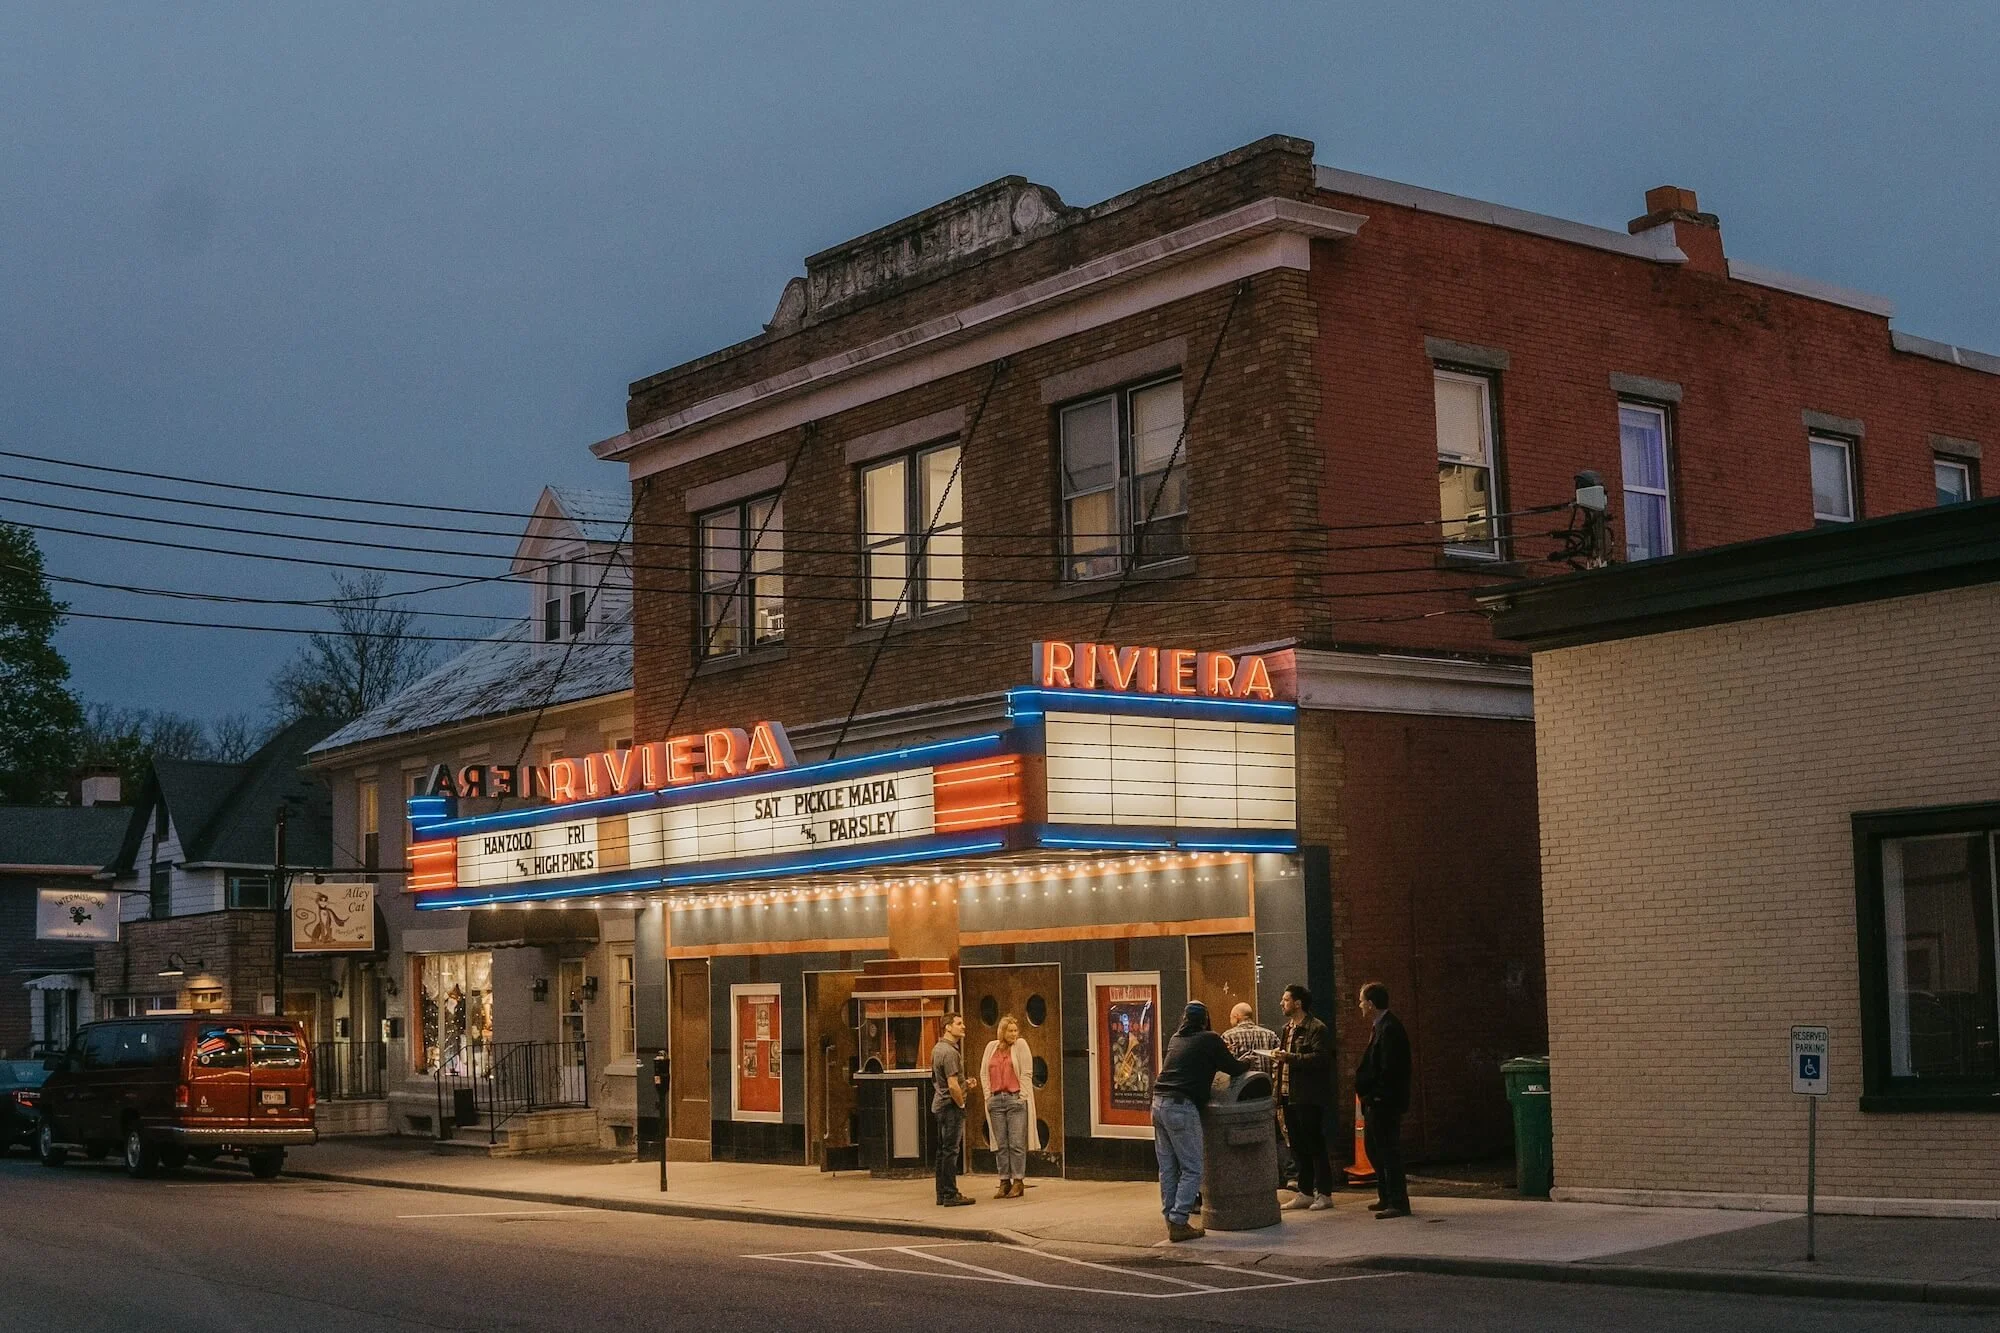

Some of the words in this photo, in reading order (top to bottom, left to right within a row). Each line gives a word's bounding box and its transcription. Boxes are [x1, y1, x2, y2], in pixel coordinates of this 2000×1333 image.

[1040, 641, 1275, 699] RIVIERA
[549, 721, 788, 803] RIVIERA
[755, 797, 781, 819] SAT
[795, 789, 845, 815] PICKLE
[850, 779, 898, 807] MAFIA
[484, 832, 532, 855] HANZOLO
[567, 825, 585, 845] FRI
[801, 824, 817, 844] AND
[829, 811, 896, 841] PARSLEY
[534, 855, 560, 875] HIGH
[562, 851, 594, 873] PINES
[342, 887, 370, 901] Alley
[348, 902, 367, 913] Cat
[1792, 1031, 1827, 1041] RESERVED
[1795, 1043, 1825, 1053] PARKING
